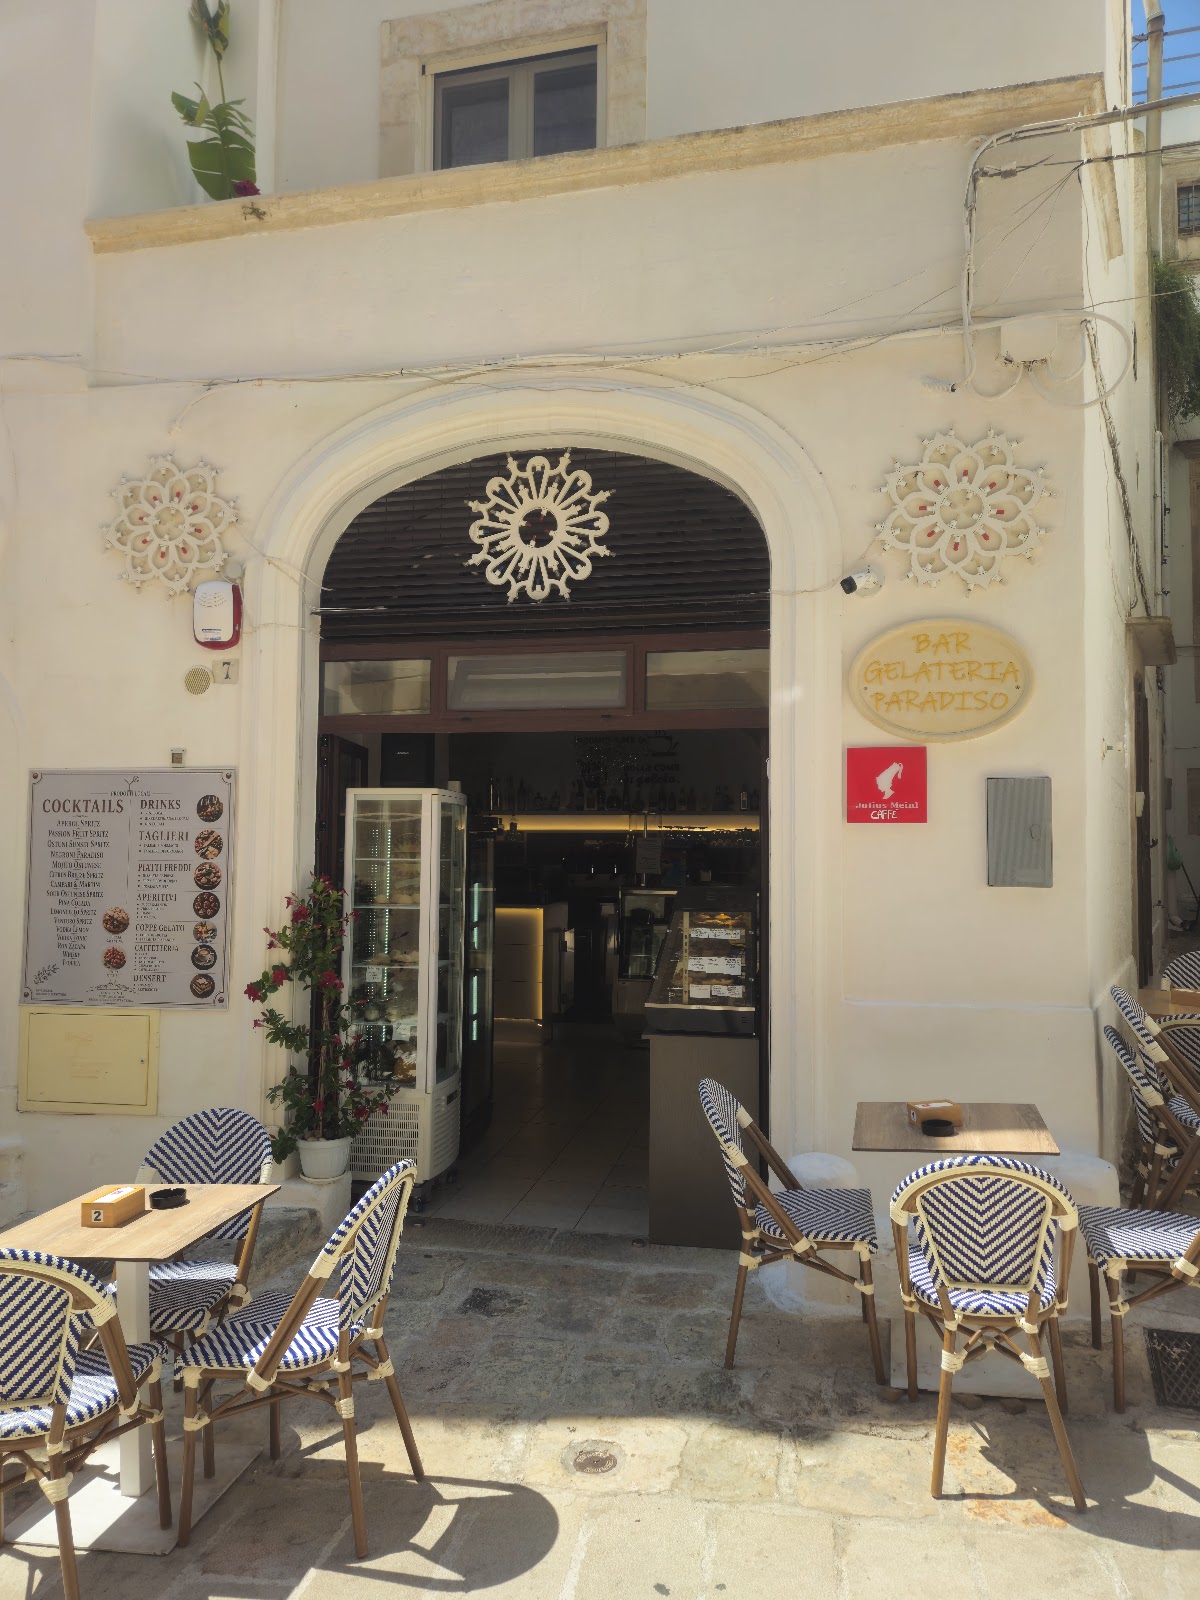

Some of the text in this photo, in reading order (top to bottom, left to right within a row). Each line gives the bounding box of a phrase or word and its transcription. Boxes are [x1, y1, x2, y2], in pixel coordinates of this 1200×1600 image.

[912, 632, 972, 655] BAR
[222, 661, 231, 680] 7
[864, 661, 1019, 684] GELATERIA
[870, 690, 1009, 712] PARADISO
[42, 798, 124, 814] COCKTAILS
[140, 799, 181, 810] DRINKS
[855, 801, 919, 809] Julius Meinl
[48, 829, 109, 838] PASSION FRUIT SPRITZ
[139, 830, 189, 841] TAGLIERI
[47, 839, 68, 848] OSTUNI
[90, 839, 110, 848] SPRITZ
[50, 850, 104, 859] NEGRONI PARADISO
[52, 860, 73, 869] MOJITO
[138, 863, 191, 872] PIATTI FREDDI
[86, 871, 104, 879] SPRITZ
[50, 880, 73, 888] CAMPARI
[86, 890, 104, 898] SPRITZ
[137, 893, 177, 902] APERITIVI
[135, 923, 185, 932] COPPE GELATO
[134, 944, 179, 952] CAFFETTERIA
[133, 974, 167, 983] DESSERT
[93, 1211, 101, 1221] 2
